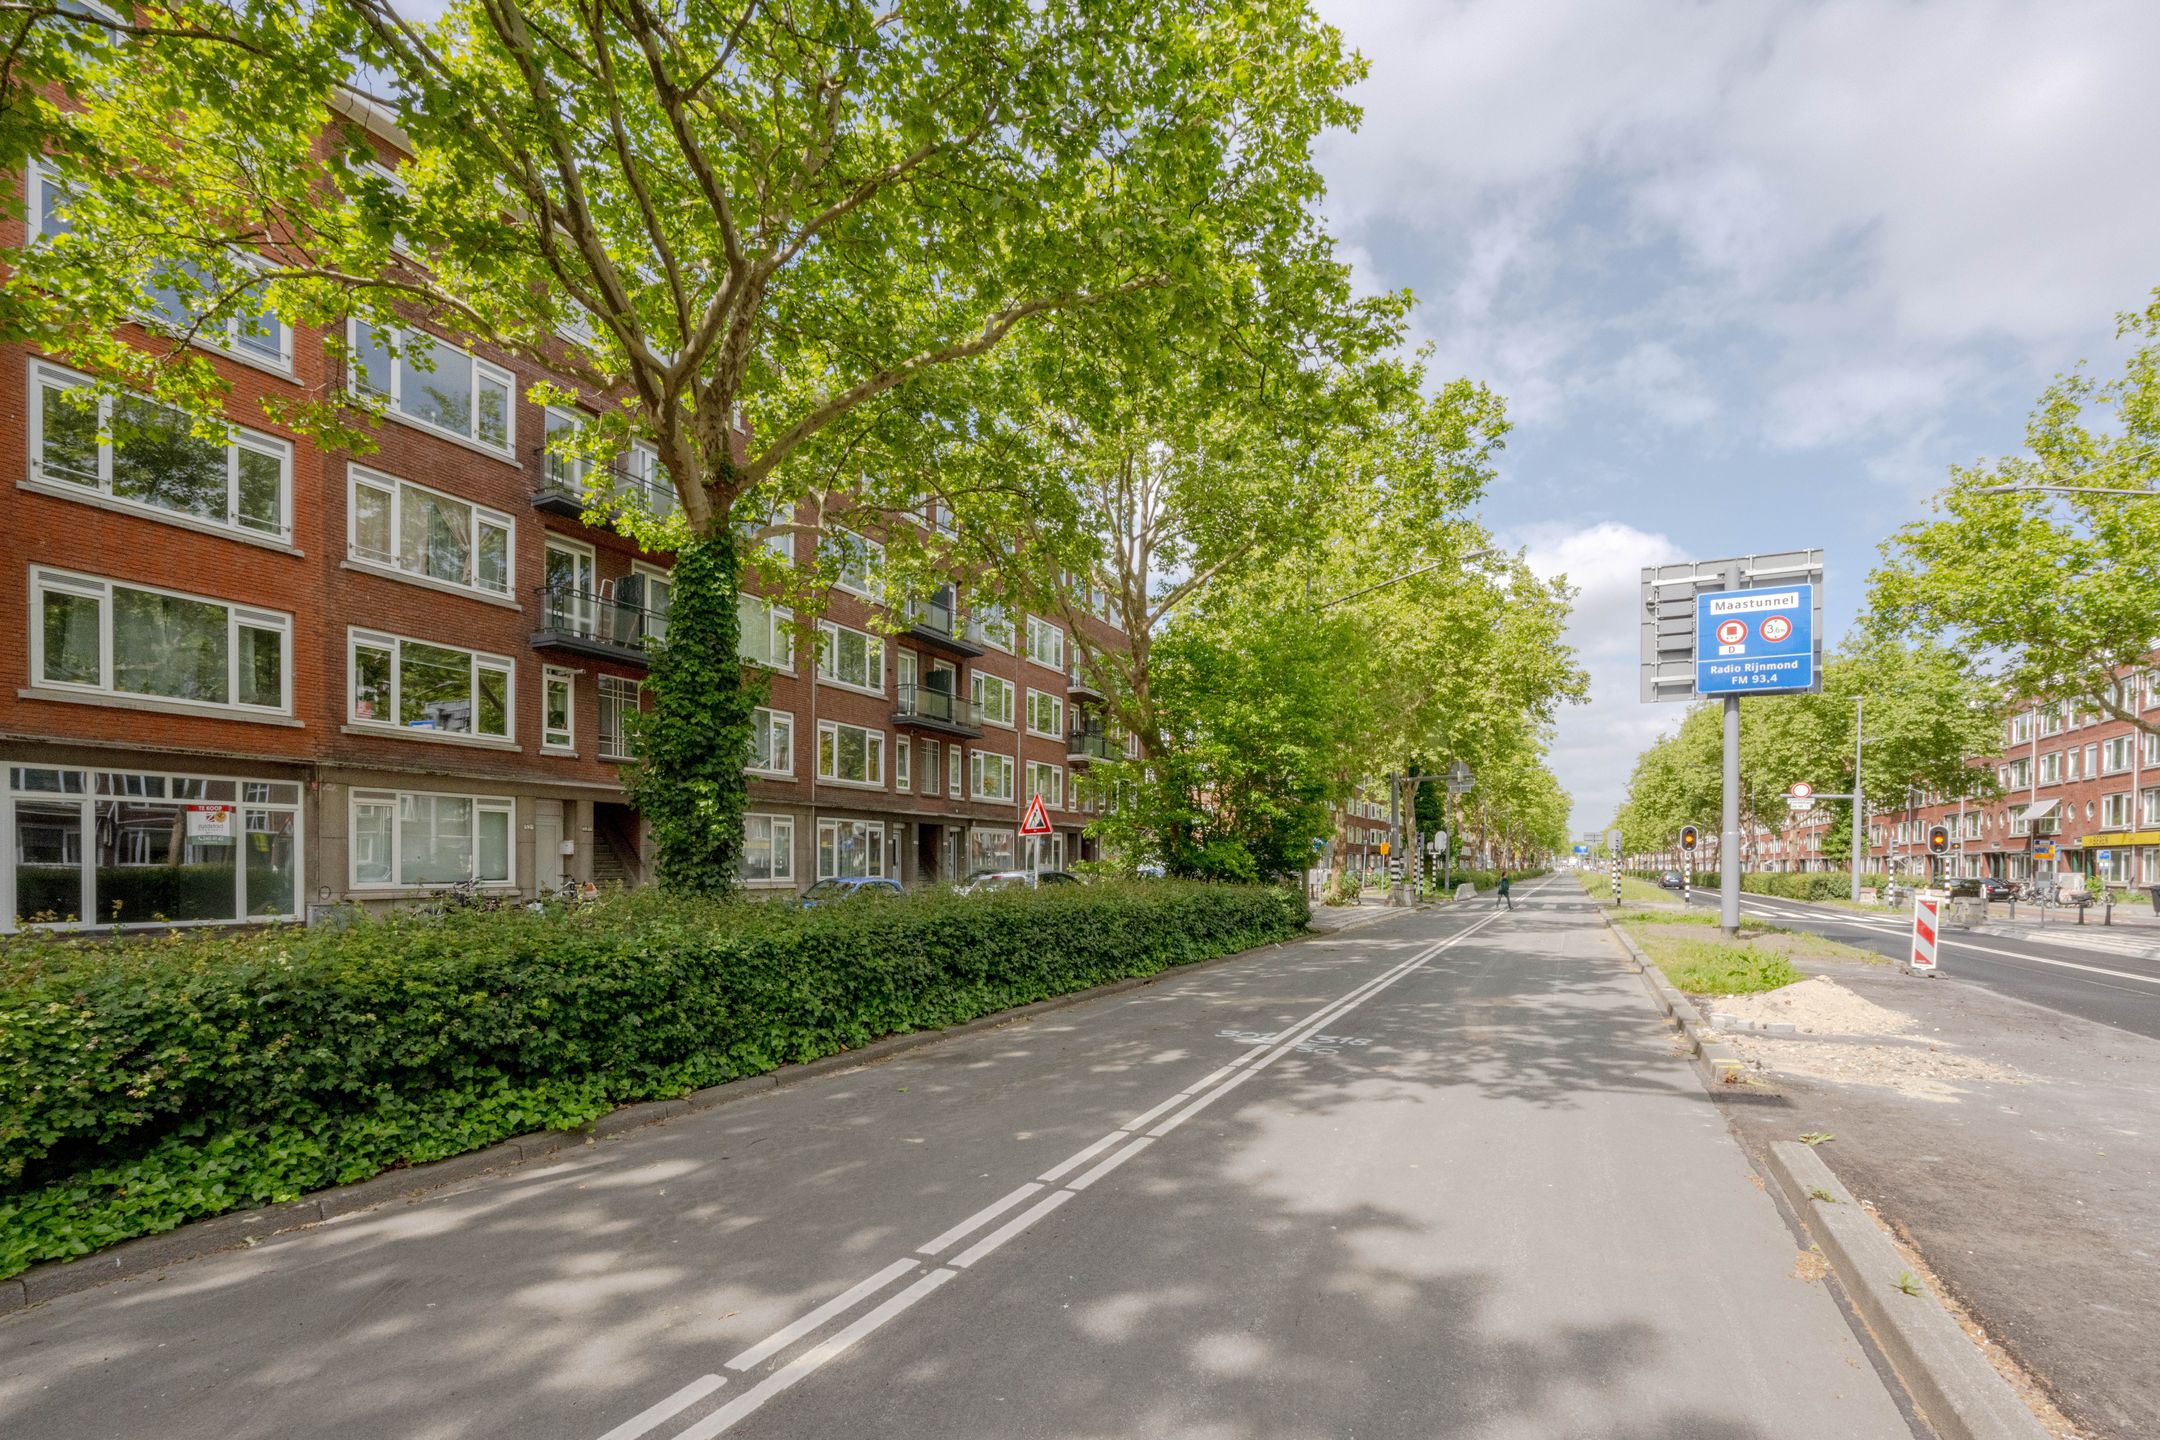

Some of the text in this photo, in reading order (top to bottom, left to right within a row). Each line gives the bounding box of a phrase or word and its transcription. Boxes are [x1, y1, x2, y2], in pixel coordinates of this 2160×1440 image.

[1715, 595, 1794, 611] Maastunnel
[1728, 646, 1736, 654] D
[1710, 660, 1798, 675] Radio Rijnmond
[1732, 676, 1748, 685] FM
